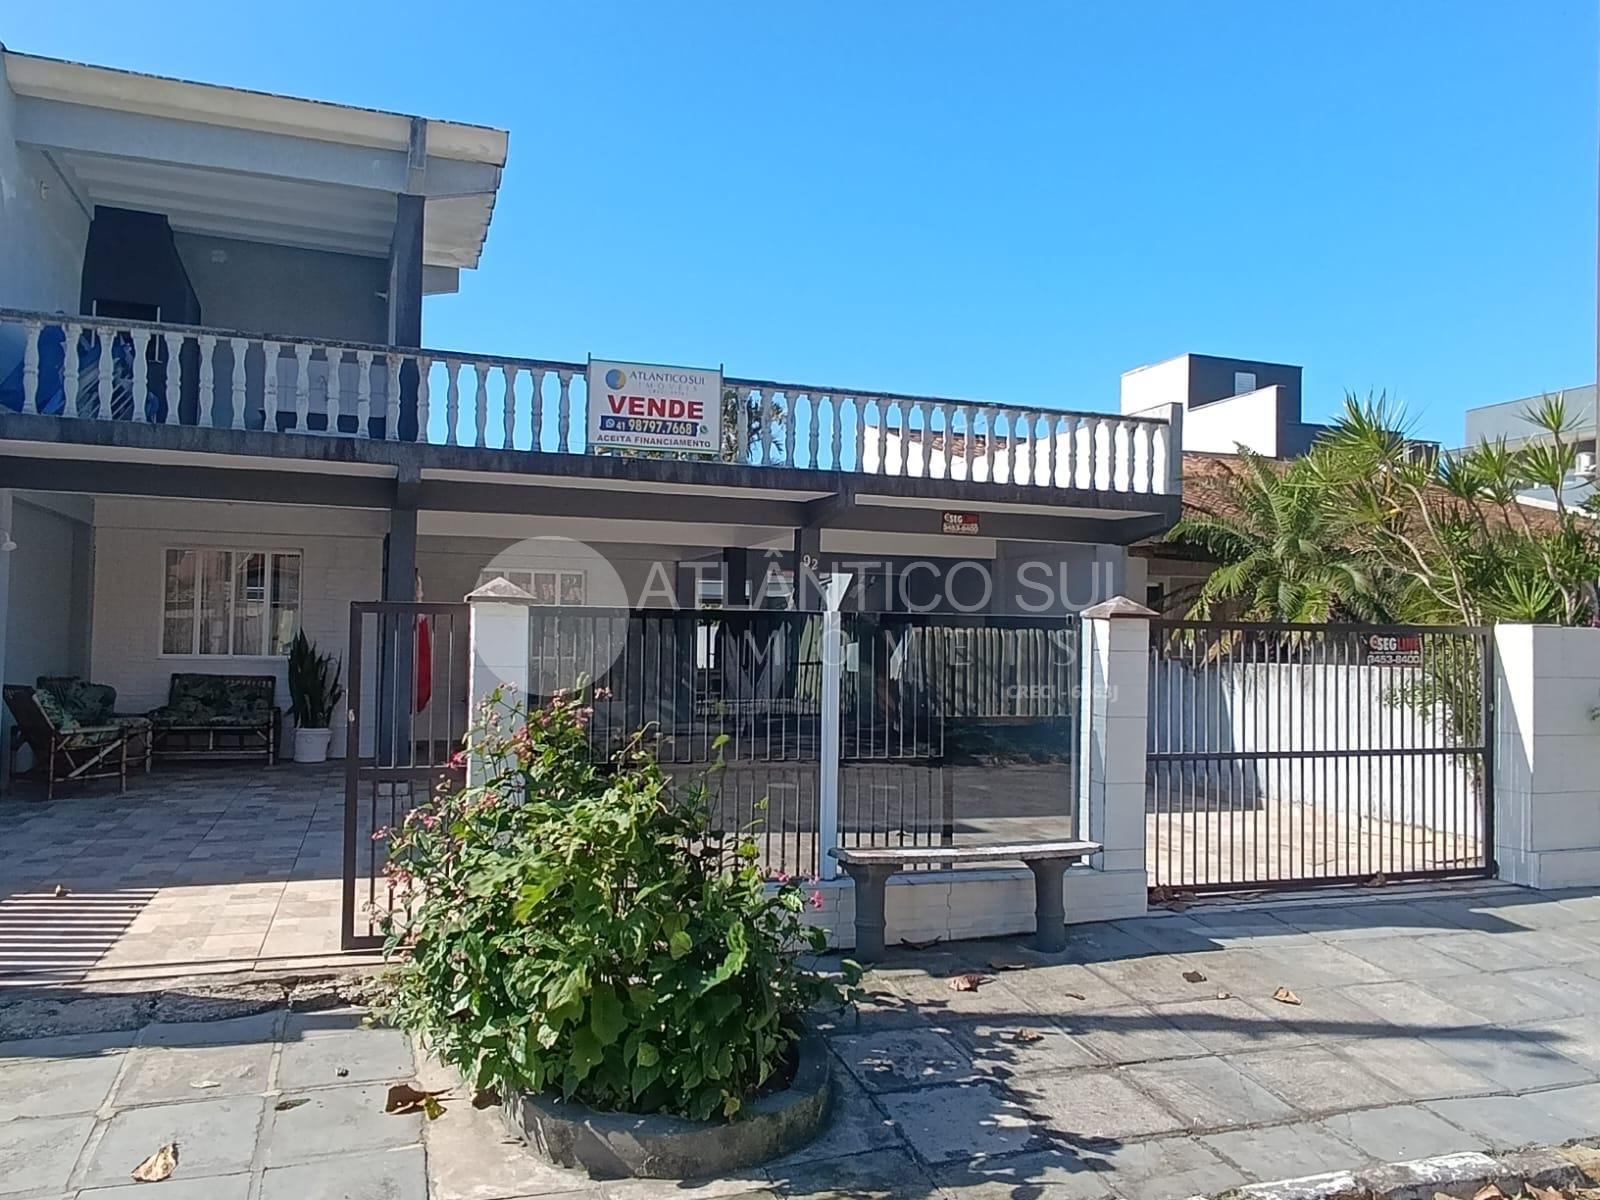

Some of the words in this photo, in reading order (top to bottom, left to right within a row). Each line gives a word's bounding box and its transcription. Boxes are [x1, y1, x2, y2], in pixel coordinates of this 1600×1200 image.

[607, 394, 704, 419] VENDE
[597, 434, 632, 443] ACEITA
[634, 436, 711, 448] FINANCIAMENTO
